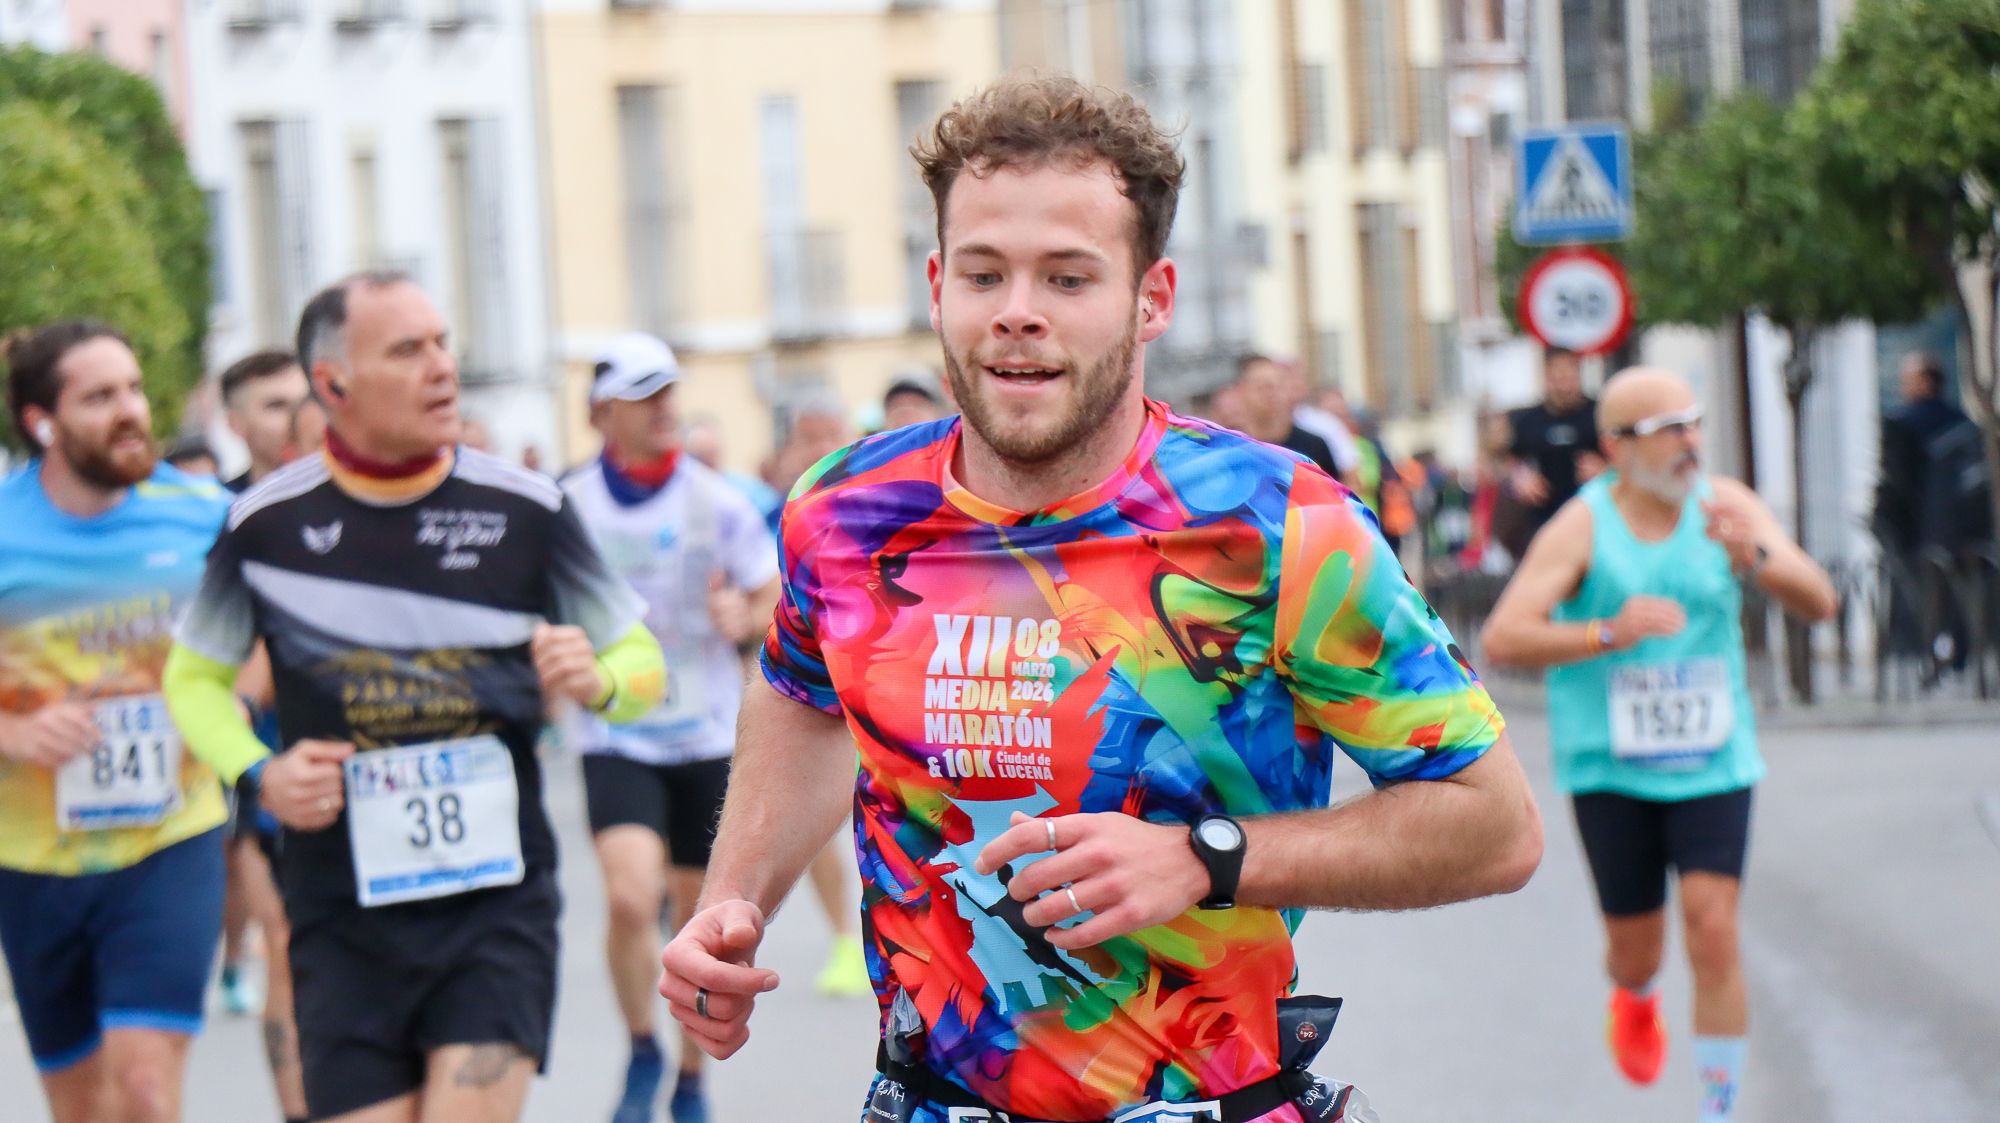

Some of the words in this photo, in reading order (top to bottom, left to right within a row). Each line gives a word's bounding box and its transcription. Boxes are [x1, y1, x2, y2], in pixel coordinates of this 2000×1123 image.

[926, 614, 1012, 677] XII
[1014, 618, 1062, 658] 08
[1011, 661, 1055, 678] MARZO
[924, 678, 1007, 712] MEDIA
[1010, 680, 1055, 702] 2026
[924, 709, 1052, 748] MARATÓN
[93, 742, 167, 789] 841
[927, 756, 943, 778] &
[942, 748, 995, 778] 10K
[996, 751, 1035, 765] Ciudad
[1037, 753, 1051, 765] de
[997, 764, 1054, 781] LUCENA
[406, 793, 465, 848] 38
